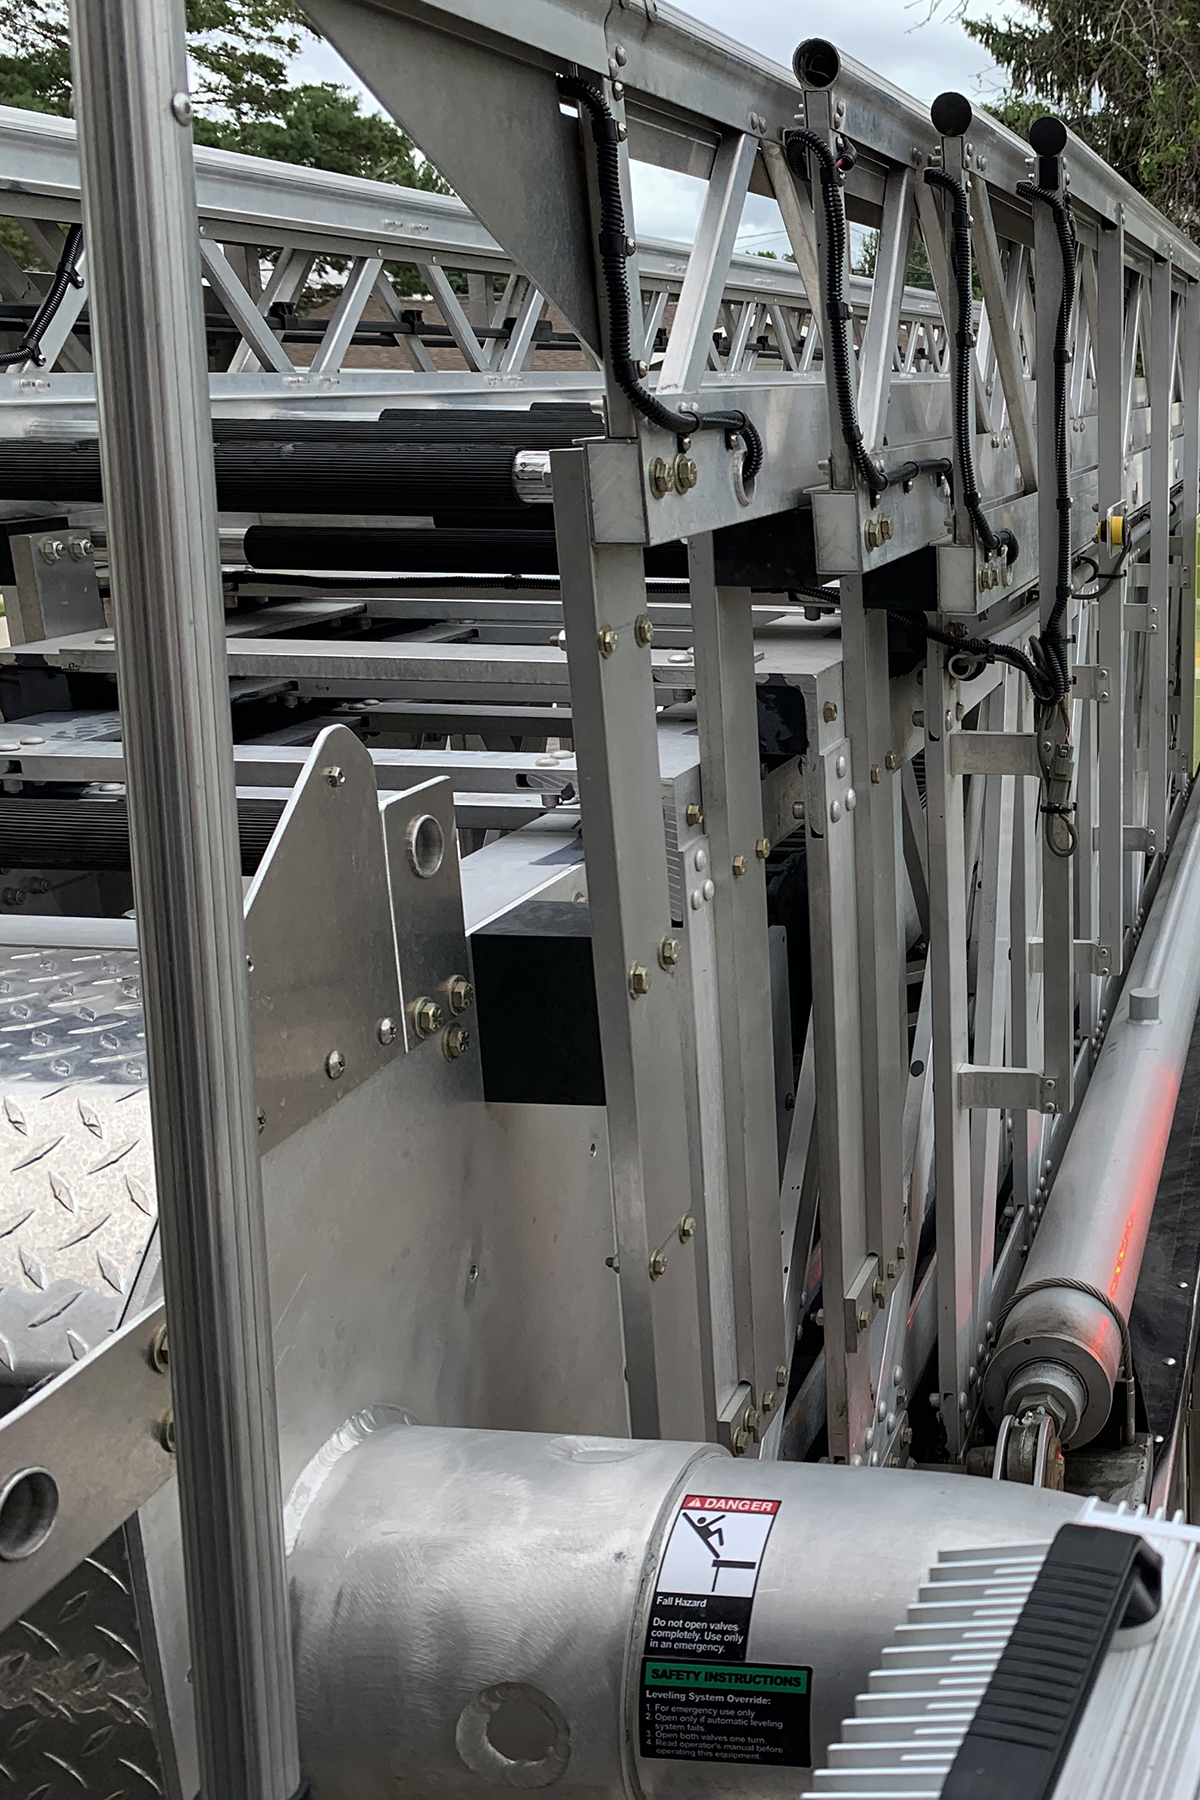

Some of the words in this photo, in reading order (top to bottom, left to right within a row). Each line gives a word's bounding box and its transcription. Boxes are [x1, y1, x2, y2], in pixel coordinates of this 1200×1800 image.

[704, 1499, 773, 1511] DANGER
[656, 1596, 673, 1605] Fall
[674, 1597, 707, 1608] Hazard
[653, 1617, 666, 1627] Do
[684, 1621, 707, 1630] open
[710, 1622, 738, 1631] valves
[651, 1630, 701, 1641] completely.
[704, 1632, 721, 1640] Use
[723, 1634, 744, 1644] only
[650, 1639, 658, 1648] in
[674, 1642, 725, 1654] emergency.
[651, 1669, 702, 1681] SAFETY
[705, 1672, 801, 1687] INSTRUCTIONS
[646, 1690, 686, 1701] Leveling
[689, 1692, 724, 1702] System
[727, 1695, 771, 1705] Override:
[655, 1704, 669, 1712] For
[671, 1706, 717, 1716] emergency
[737, 1709, 755, 1718] only
[655, 1713, 677, 1722] Open
[680, 1715, 697, 1724] only
[707, 1717, 748, 1726] automatic
[751, 1719, 783, 1729] leveling
[655, 1723, 685, 1731] system
[655, 1731, 678, 1739] Open
[680, 1732, 699, 1740] both
[701, 1734, 728, 1742] valves
[656, 1739, 677, 1747] Read
[679, 1742, 721, 1750] operator's
[756, 1745, 783, 1753] before
[656, 1748, 695, 1757] operating
